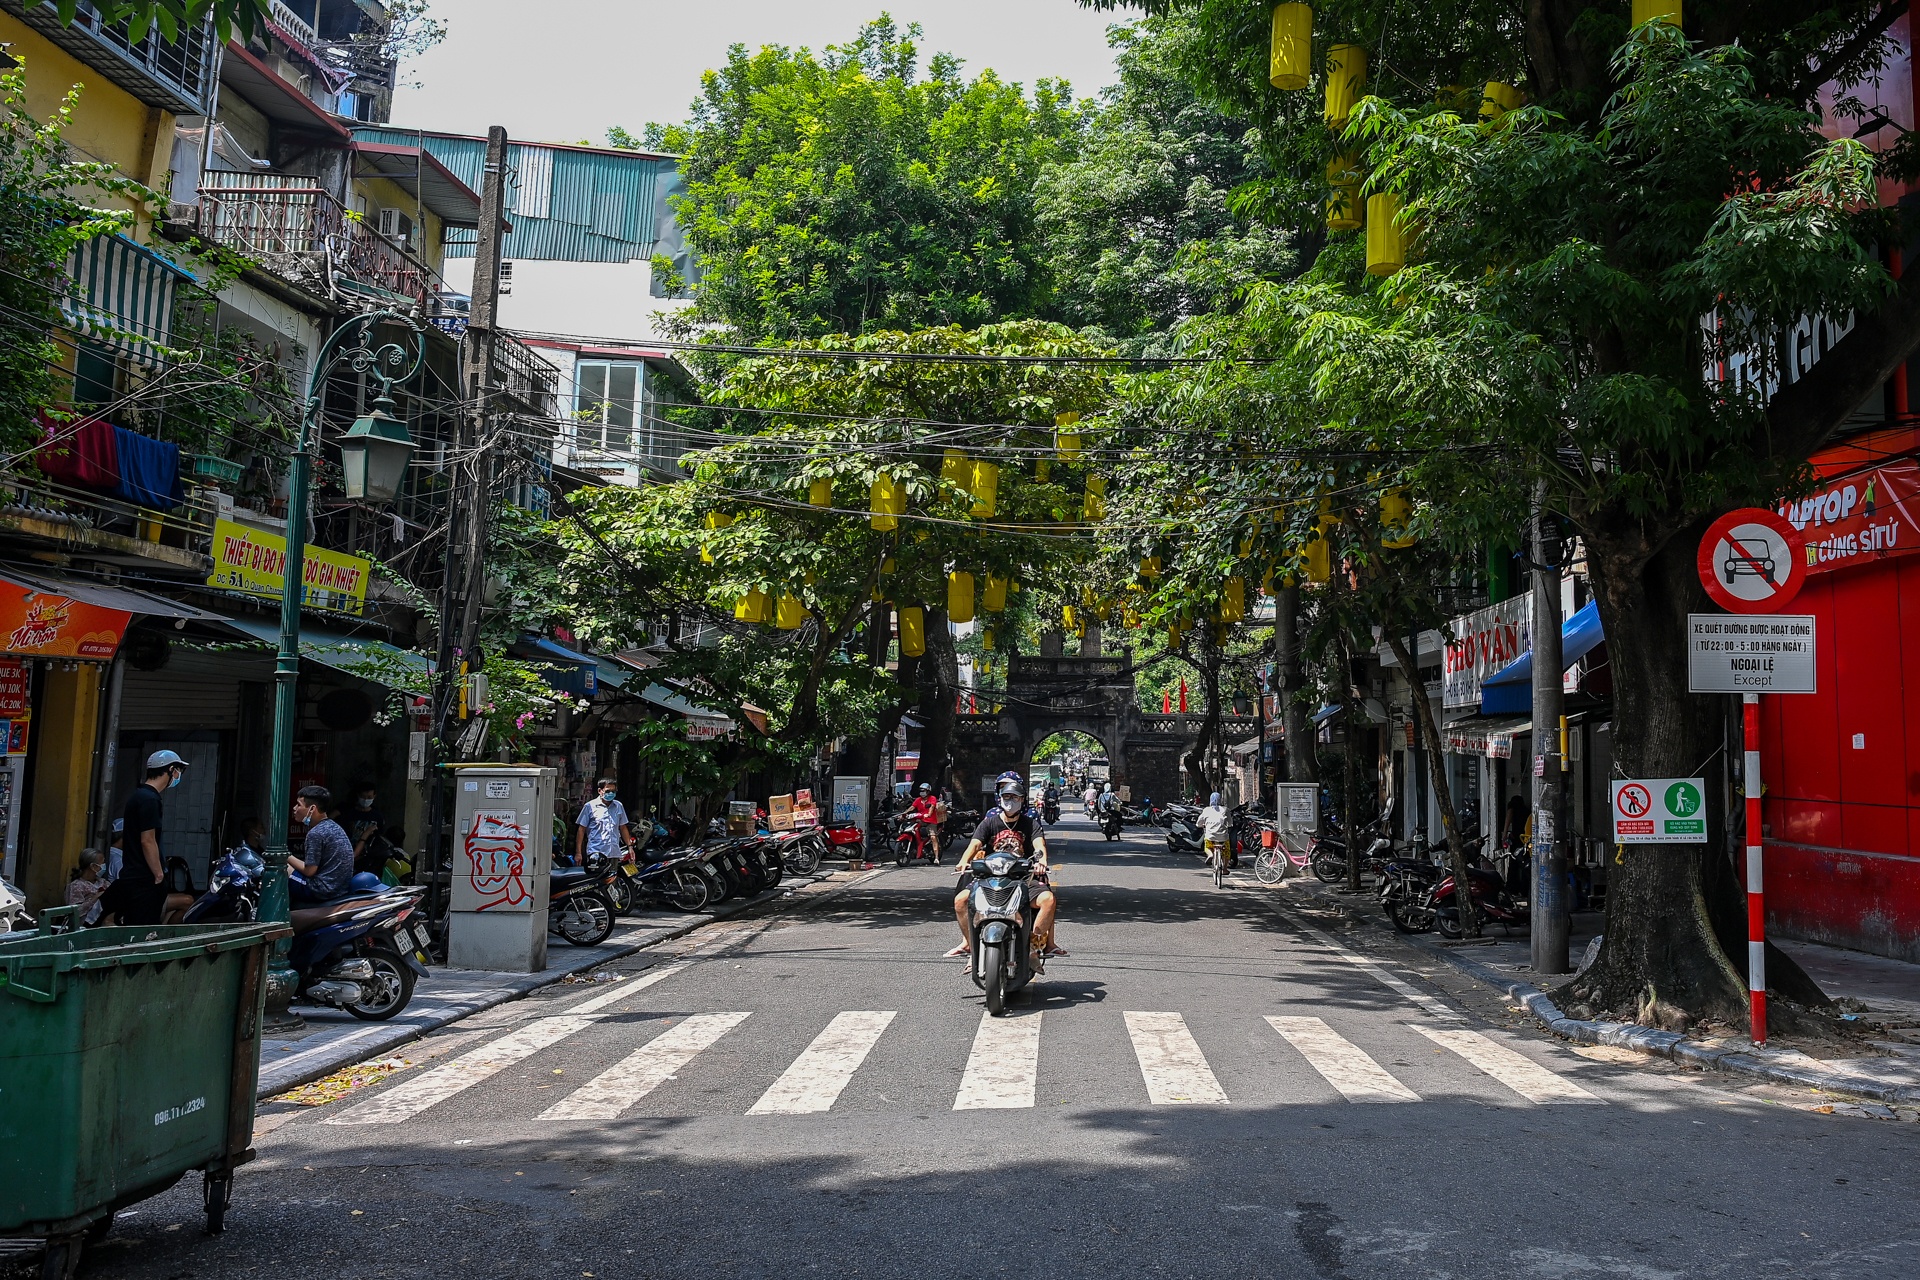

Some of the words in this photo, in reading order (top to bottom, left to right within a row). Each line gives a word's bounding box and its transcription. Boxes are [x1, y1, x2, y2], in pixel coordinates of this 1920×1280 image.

[223, 531, 252, 566] THIẾT
[252, 545, 263, 575] BỊ
[263, 548, 277, 573] ĐO
[1819, 533, 1857, 562] CÙNG
[229, 571, 243, 587] 5A
[306, 556, 319, 587] ĐỘ
[319, 563, 334, 585] GIA
[334, 565, 360, 596] NHIỆT
[1695, 624, 1702, 633] XE
[1705, 622, 1722, 634] QUÉT
[1724, 622, 1748, 634] ĐƯỜNG
[1750, 624, 1768, 636] ĐƯỢC
[1771, 625, 1788, 636] HOẠT
[1791, 623, 1809, 637] ĐỘNG
[1446, 622, 1476, 674] PHỞ
[1479, 616, 1518, 664] VÂN
[1762, 640, 1780, 651] HÀNG
[1731, 658, 1759, 672] NGOẠI
[1764, 657, 1774, 673] LỆ
[12, 668, 20, 678] 3K
[1735, 674, 1772, 687] Except
[8, 684, 20, 693] 10K
[9, 700, 21, 709] 20K
